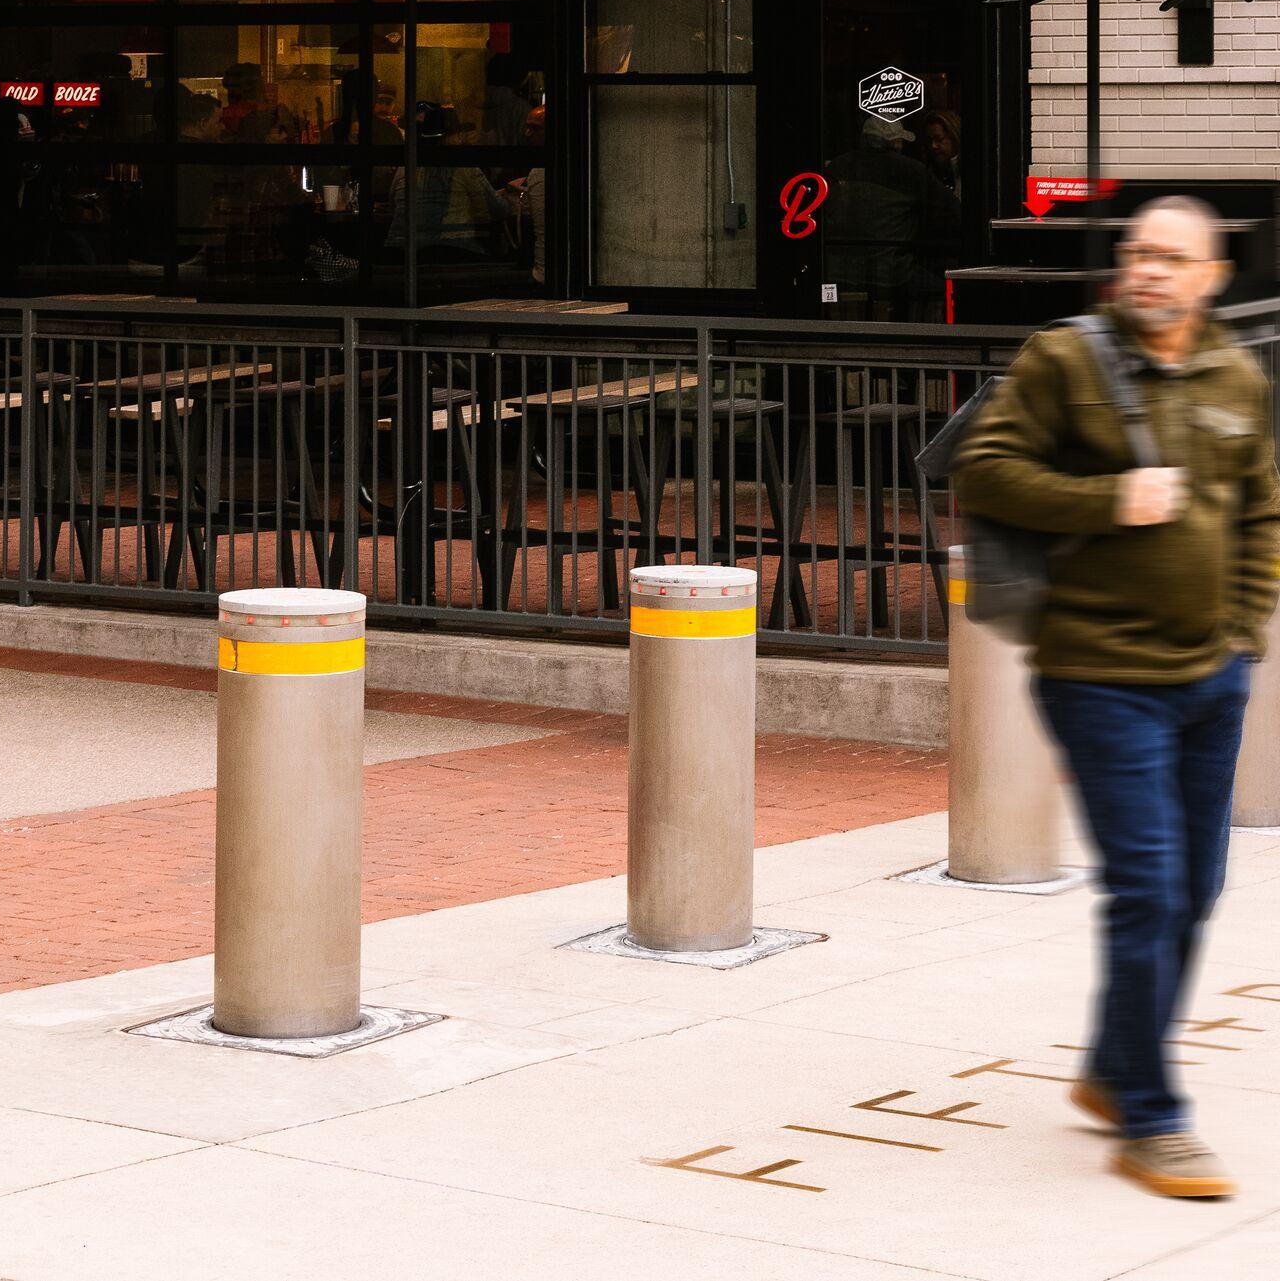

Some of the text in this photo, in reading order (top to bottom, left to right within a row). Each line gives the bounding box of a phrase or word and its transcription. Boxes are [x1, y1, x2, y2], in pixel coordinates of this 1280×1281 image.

[5, 85, 100, 102] COLD BOOZE
[861, 81, 921, 107] Hattie B's
[779, 172, 828, 239] B
